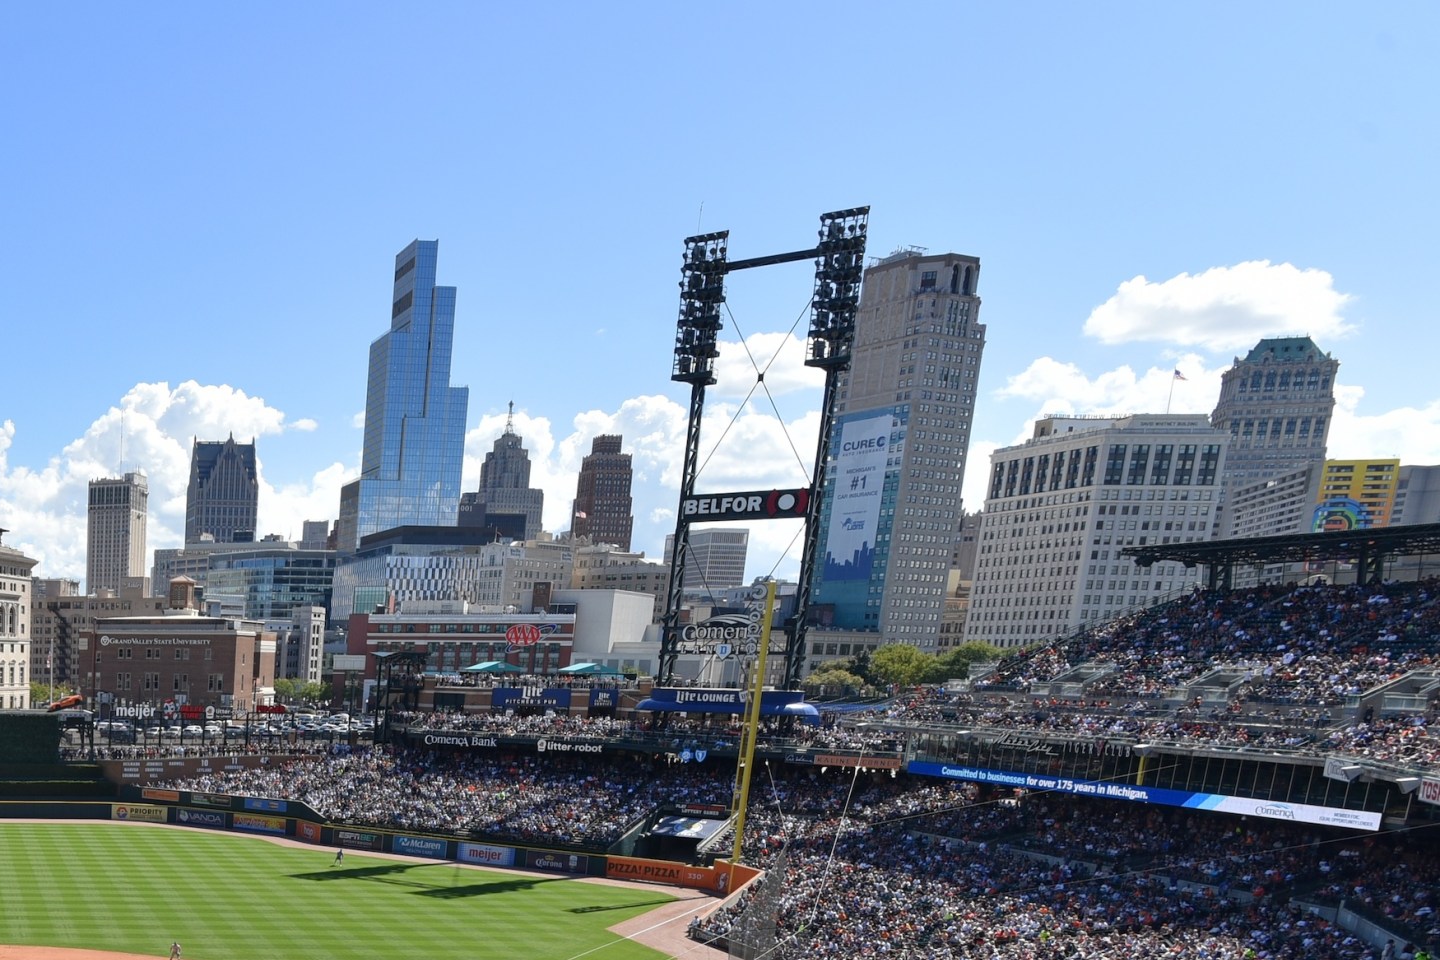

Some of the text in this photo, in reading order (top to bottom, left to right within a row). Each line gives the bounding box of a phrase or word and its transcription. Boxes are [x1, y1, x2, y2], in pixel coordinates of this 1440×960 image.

[843, 438, 876, 451] CURE
[850, 474, 867, 490] #1
[684, 495, 762, 515] BELFOR
[109, 637, 211, 645] GRAND VALLEY STATE UNIVERSITY
[509, 625, 539, 644] AAA
[676, 691, 735, 704] Lite LOUNGE
[115, 702, 156, 720] meijer
[471, 736, 498, 748] Bank
[547, 741, 603, 753] litter-robot
[1062, 742, 1132, 757] TIGER CLUB
[941, 766, 1148, 800] Committed to businesses for over 175 years in Michigan.
[130, 807, 162, 816] PRIORITY
[410, 840, 441, 850] McLaren
[468, 846, 503, 861] meijer
[535, 858, 563, 868] Corona
[608, 862, 680, 879] PIZZA! PIZZA!
